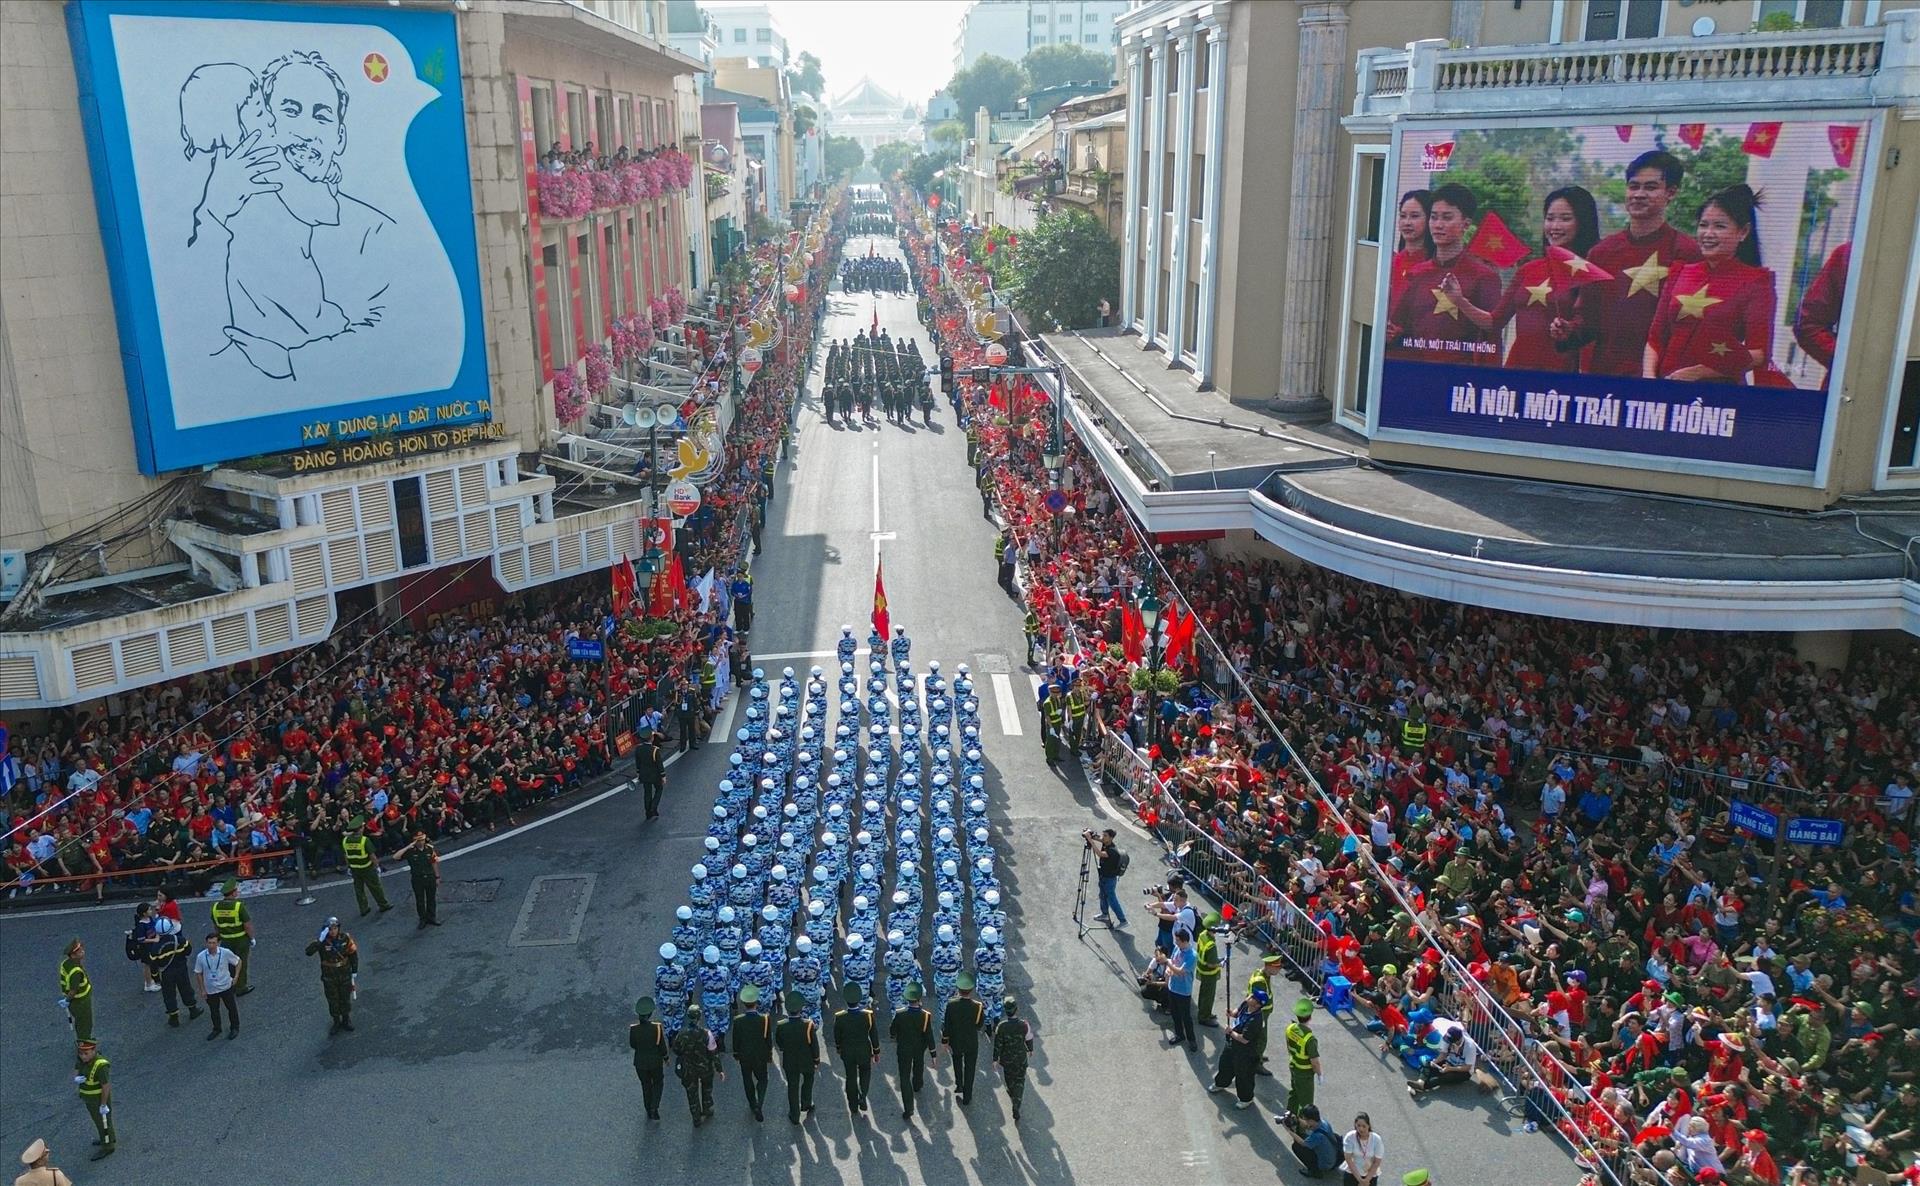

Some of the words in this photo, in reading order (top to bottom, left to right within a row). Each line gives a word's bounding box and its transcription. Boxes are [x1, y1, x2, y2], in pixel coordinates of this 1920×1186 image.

[1462, 341, 1476, 352] TIM
[302, 420, 331, 441] XÂY
[476, 399, 491, 414] TA
[1451, 382, 1476, 415] HÀ
[1479, 385, 1520, 423] NỘI,
[1523, 389, 1572, 428] MỘT
[1574, 393, 1622, 428] TRÁI
[1625, 400, 1668, 432] TIM
[1669, 396, 1737, 438] HỒNG
[292, 449, 337, 472] ĐÀNG
[342, 440, 394, 464] HOÀNG
[431, 432, 449, 448] TO
[452, 427, 475, 447] ĐẸP
